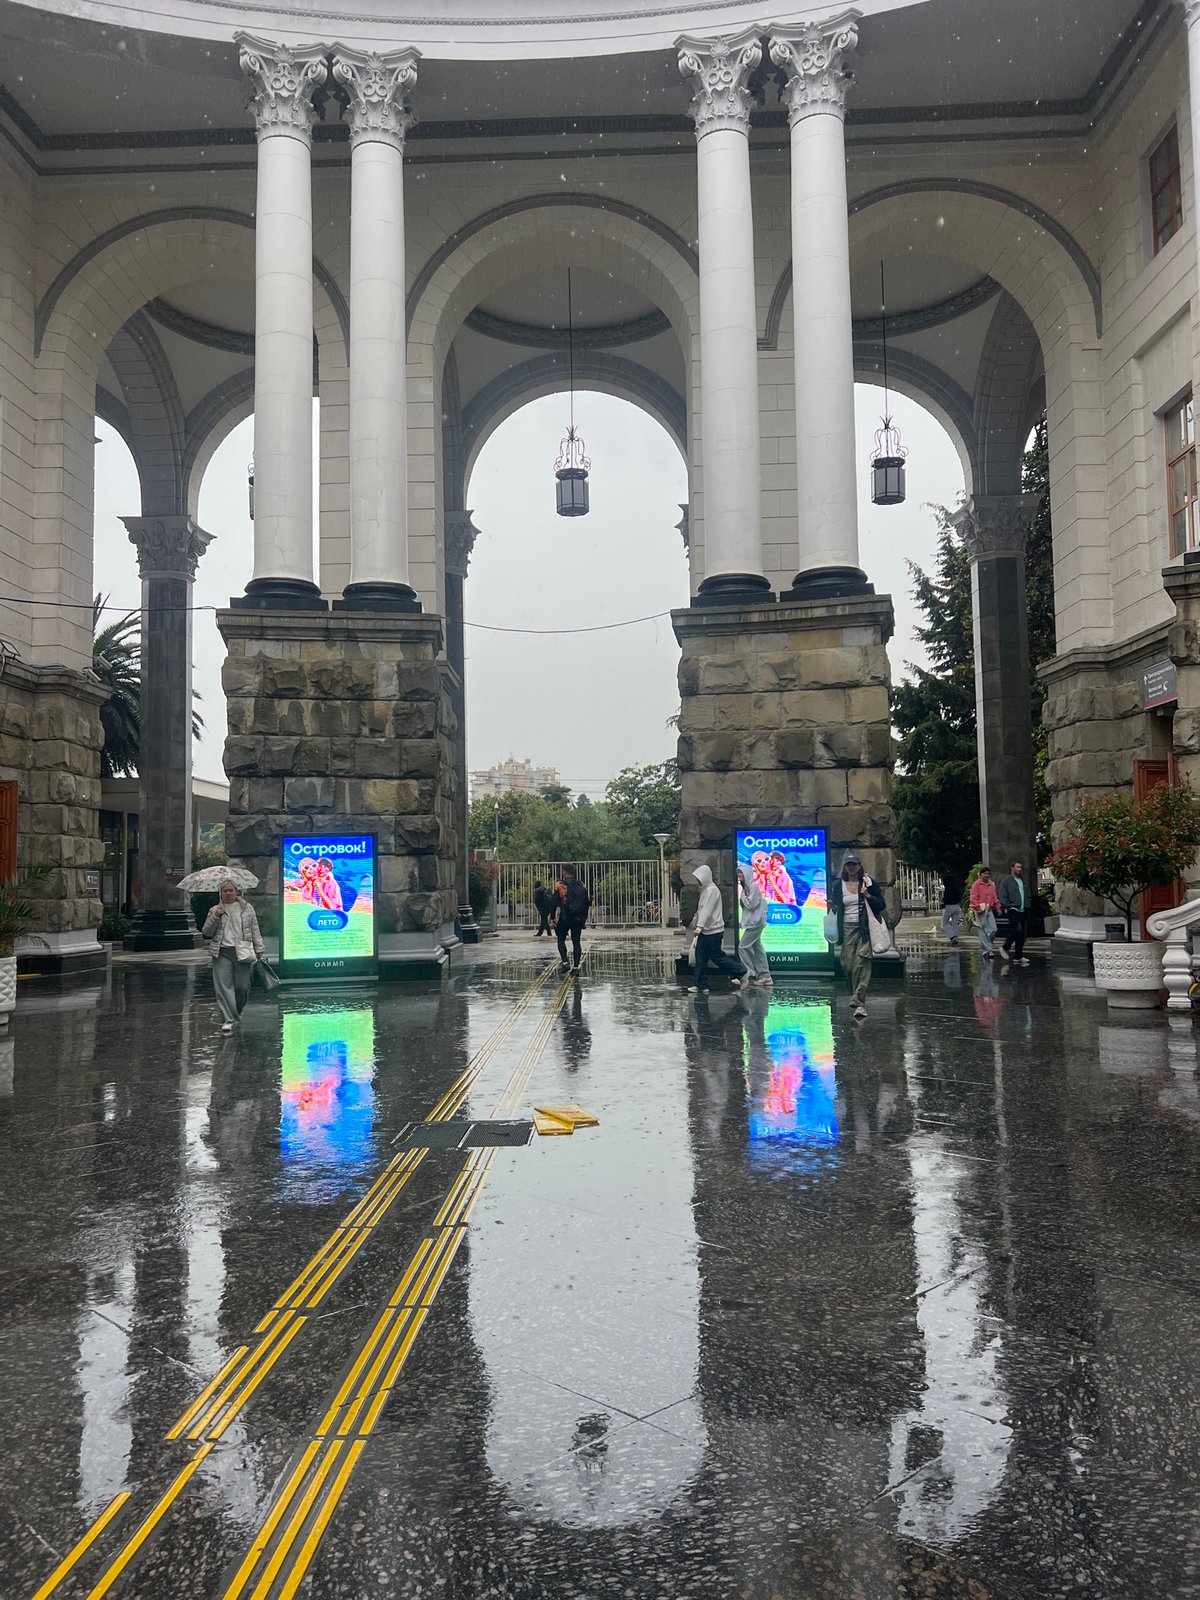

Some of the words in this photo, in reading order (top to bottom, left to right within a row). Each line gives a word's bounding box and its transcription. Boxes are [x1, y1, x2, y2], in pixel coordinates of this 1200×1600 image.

[290, 841, 366, 856] Островок!
[743, 835, 818, 850] Островок!
[314, 960, 345, 968] ОЛИМП
